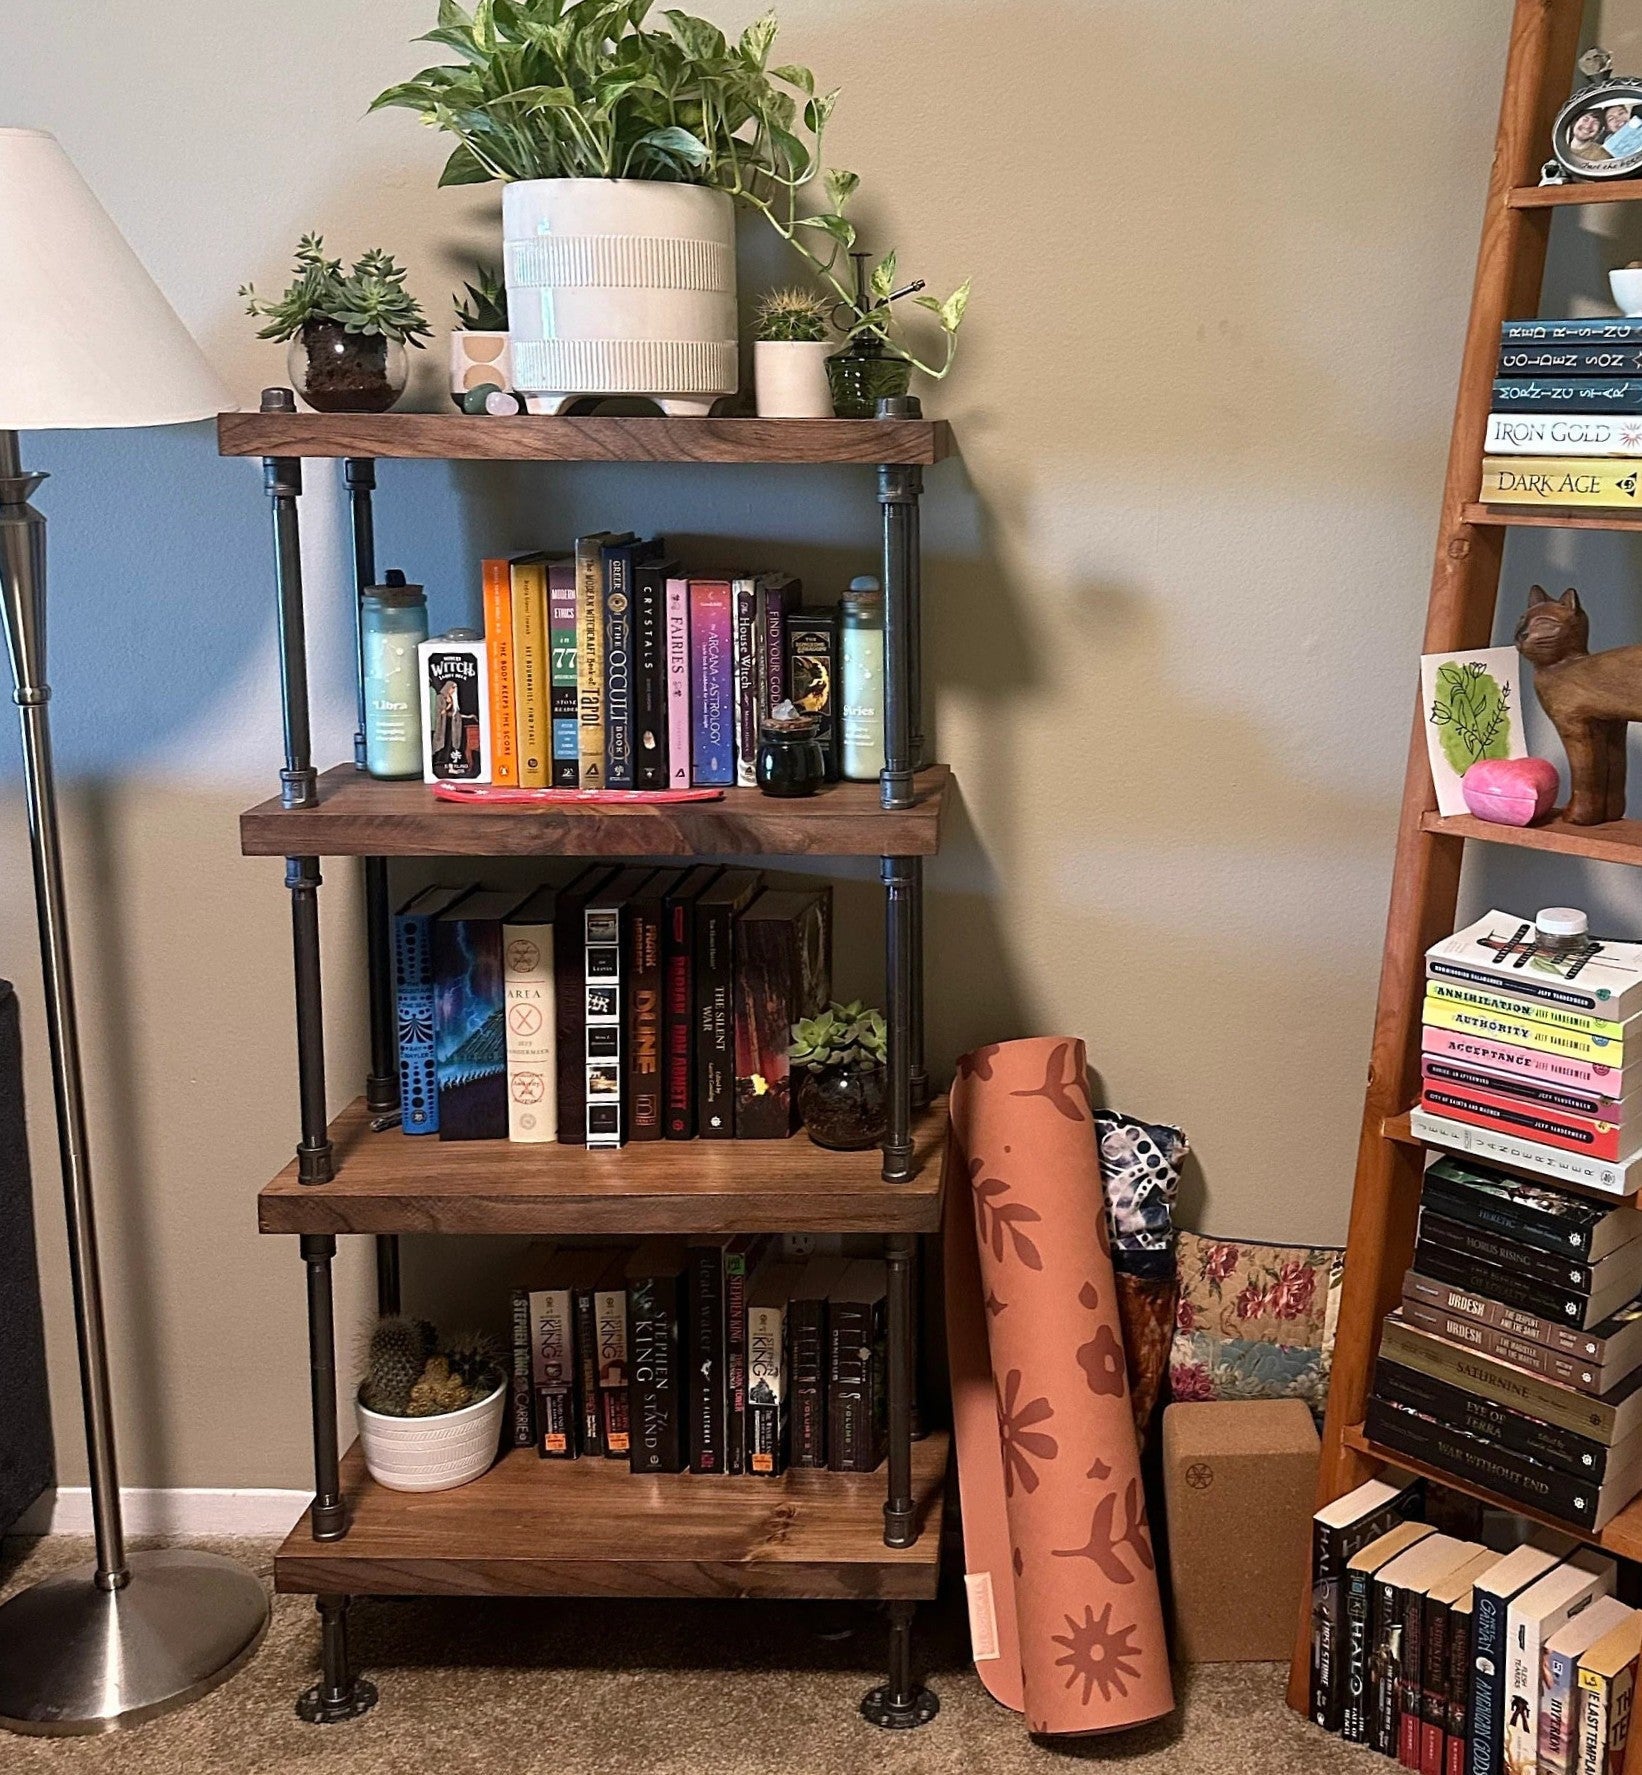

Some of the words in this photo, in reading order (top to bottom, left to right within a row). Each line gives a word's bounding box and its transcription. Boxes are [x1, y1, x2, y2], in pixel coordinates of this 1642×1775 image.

[1509, 326, 1546, 338] RED
[1553, 325, 1631, 338] RISING
[1503, 353, 1578, 367] GOLDEN
[1585, 353, 1624, 367] SON
[1499, 381, 1574, 400] MORNING
[1579, 382, 1630, 399] STAR
[1494, 421, 1546, 446] IRON
[1551, 421, 1611, 442] GOLD
[1497, 471, 1556, 498] DARK
[1558, 473, 1601, 493] AGE
[584, 575, 595, 607] MODERN
[553, 607, 575, 619] ETHICS
[643, 586, 654, 669] CRYSTALS
[768, 610, 780, 638] FIND
[585, 609, 597, 656] WITCHCRAFT
[613, 624, 622, 648] THE
[670, 616, 685, 674] FAIRIES
[739, 617, 751, 653] House
[431, 661, 476, 678] WITCH
[552, 648, 578, 668] 77
[586, 658, 596, 675] Book
[707, 631, 720, 676] ARCANA
[740, 654, 753, 689] Witch
[769, 640, 781, 672] YOUR
[501, 685, 509, 709] KEEPS
[588, 677, 597, 686] of
[608, 650, 628, 725] OCCULT
[372, 700, 408, 711] Libra
[709, 680, 721, 746] ASTROLOGY
[503, 731, 511, 756] SCORE
[614, 726, 624, 753] BOOK
[633, 917, 643, 974] HERBERT
[645, 924, 657, 967] FRANK
[507, 990, 541, 999] AREA
[715, 985, 725, 1009] THE
[1437, 986, 1530, 1015] ANNIHILATION
[1535, 1009, 1549, 1018] JEFF
[1551, 1012, 1590, 1029] VANDERMEER
[1537, 988, 1552, 997] JEFF
[1553, 992, 1589, 1006] VANDERMEER
[633, 989, 657, 1075] DUNE
[702, 1005, 713, 1032] WAR
[715, 1011, 726, 1052] SILENT
[1455, 1014, 1529, 1038] AUTHORITY
[1534, 1033, 1548, 1042] JEFF
[1550, 1036, 1590, 1052] VANDERMEER
[671, 1024, 687, 1054] DAN
[1448, 1041, 1532, 1067] ACCEPTANCE
[1535, 1061, 1548, 1070] JEFF
[1551, 1064, 1591, 1081] VANDERMEER
[671, 1058, 688, 1110] ABNETT
[1460, 1073, 1490, 1085] AFTERWORD
[1538, 1092, 1553, 1100] JEFF
[1553, 1096, 1592, 1110] VANDERMEER
[1429, 1093, 1441, 1101] CITY
[1449, 1098, 1468, 1108] SAINTS
[1468, 1103, 1479, 1111] AND
[1479, 1106, 1501, 1117] MADMEN
[1534, 1121, 1548, 1130] JEFF
[1550, 1124, 1588, 1140] VANDERMEER
[1418, 1122, 1461, 1140] JEFF
[1475, 1139, 1595, 1177] VANDERMEER
[1466, 1236, 1499, 1255] HORUS
[1499, 1248, 1532, 1266] RISING
[700, 1258, 716, 1299] dead
[729, 1275, 743, 1317] STEPHEN
[513, 1299, 528, 1346] STEPHEN
[1447, 1292, 1486, 1318] URDESH
[1505, 1309, 1514, 1320] THE
[540, 1319, 557, 1359] KING
[600, 1320, 618, 1359] KING
[700, 1306, 713, 1350] water
[729, 1319, 744, 1344] KING
[1446, 1319, 1482, 1344] URDESH
[1500, 1317, 1512, 1330] AND
[1512, 1321, 1522, 1333] THE
[1522, 1324, 1540, 1338] SAINT
[513, 1347, 530, 1376] KING
[635, 1320, 654, 1382] KING
[655, 1310, 669, 1390] STEPHEN
[752, 1336, 768, 1376] KING
[765, 1338, 775, 1376] STEPHEN
[799, 1326, 817, 1394] ALIENS
[838, 1311, 862, 1400] ALIENS
[1456, 1361, 1530, 1399] SATURNINE
[514, 1393, 530, 1433] CARRIE
[643, 1393, 657, 1448] STAND
[802, 1400, 812, 1439] VOLUME
[844, 1404, 853, 1444] VOLUME
[1465, 1415, 1503, 1439] TERRA
[1466, 1401, 1486, 1416] EYE
[1488, 1409, 1506, 1425] OF
[1437, 1440, 1464, 1461] WAR
[1465, 1452, 1523, 1484] WITHOUT
[1522, 1473, 1550, 1495] END
[1320, 1526, 1331, 1600] HALO
[1321, 1620, 1331, 1650] FIRST
[1477, 1598, 1497, 1655] GAIMAN
[1319, 1650, 1331, 1688] STRIKE
[1350, 1620, 1364, 1696] HALO
[1513, 1658, 1522, 1689] TEARERS
[1521, 1666, 1529, 1688] FLESH
[1474, 1676, 1493, 1740] AMERICAN
[1550, 1698, 1563, 1756] HYPERION
[1586, 1701, 1601, 1733] LAST
[1471, 1738, 1492, 1775] GODS
